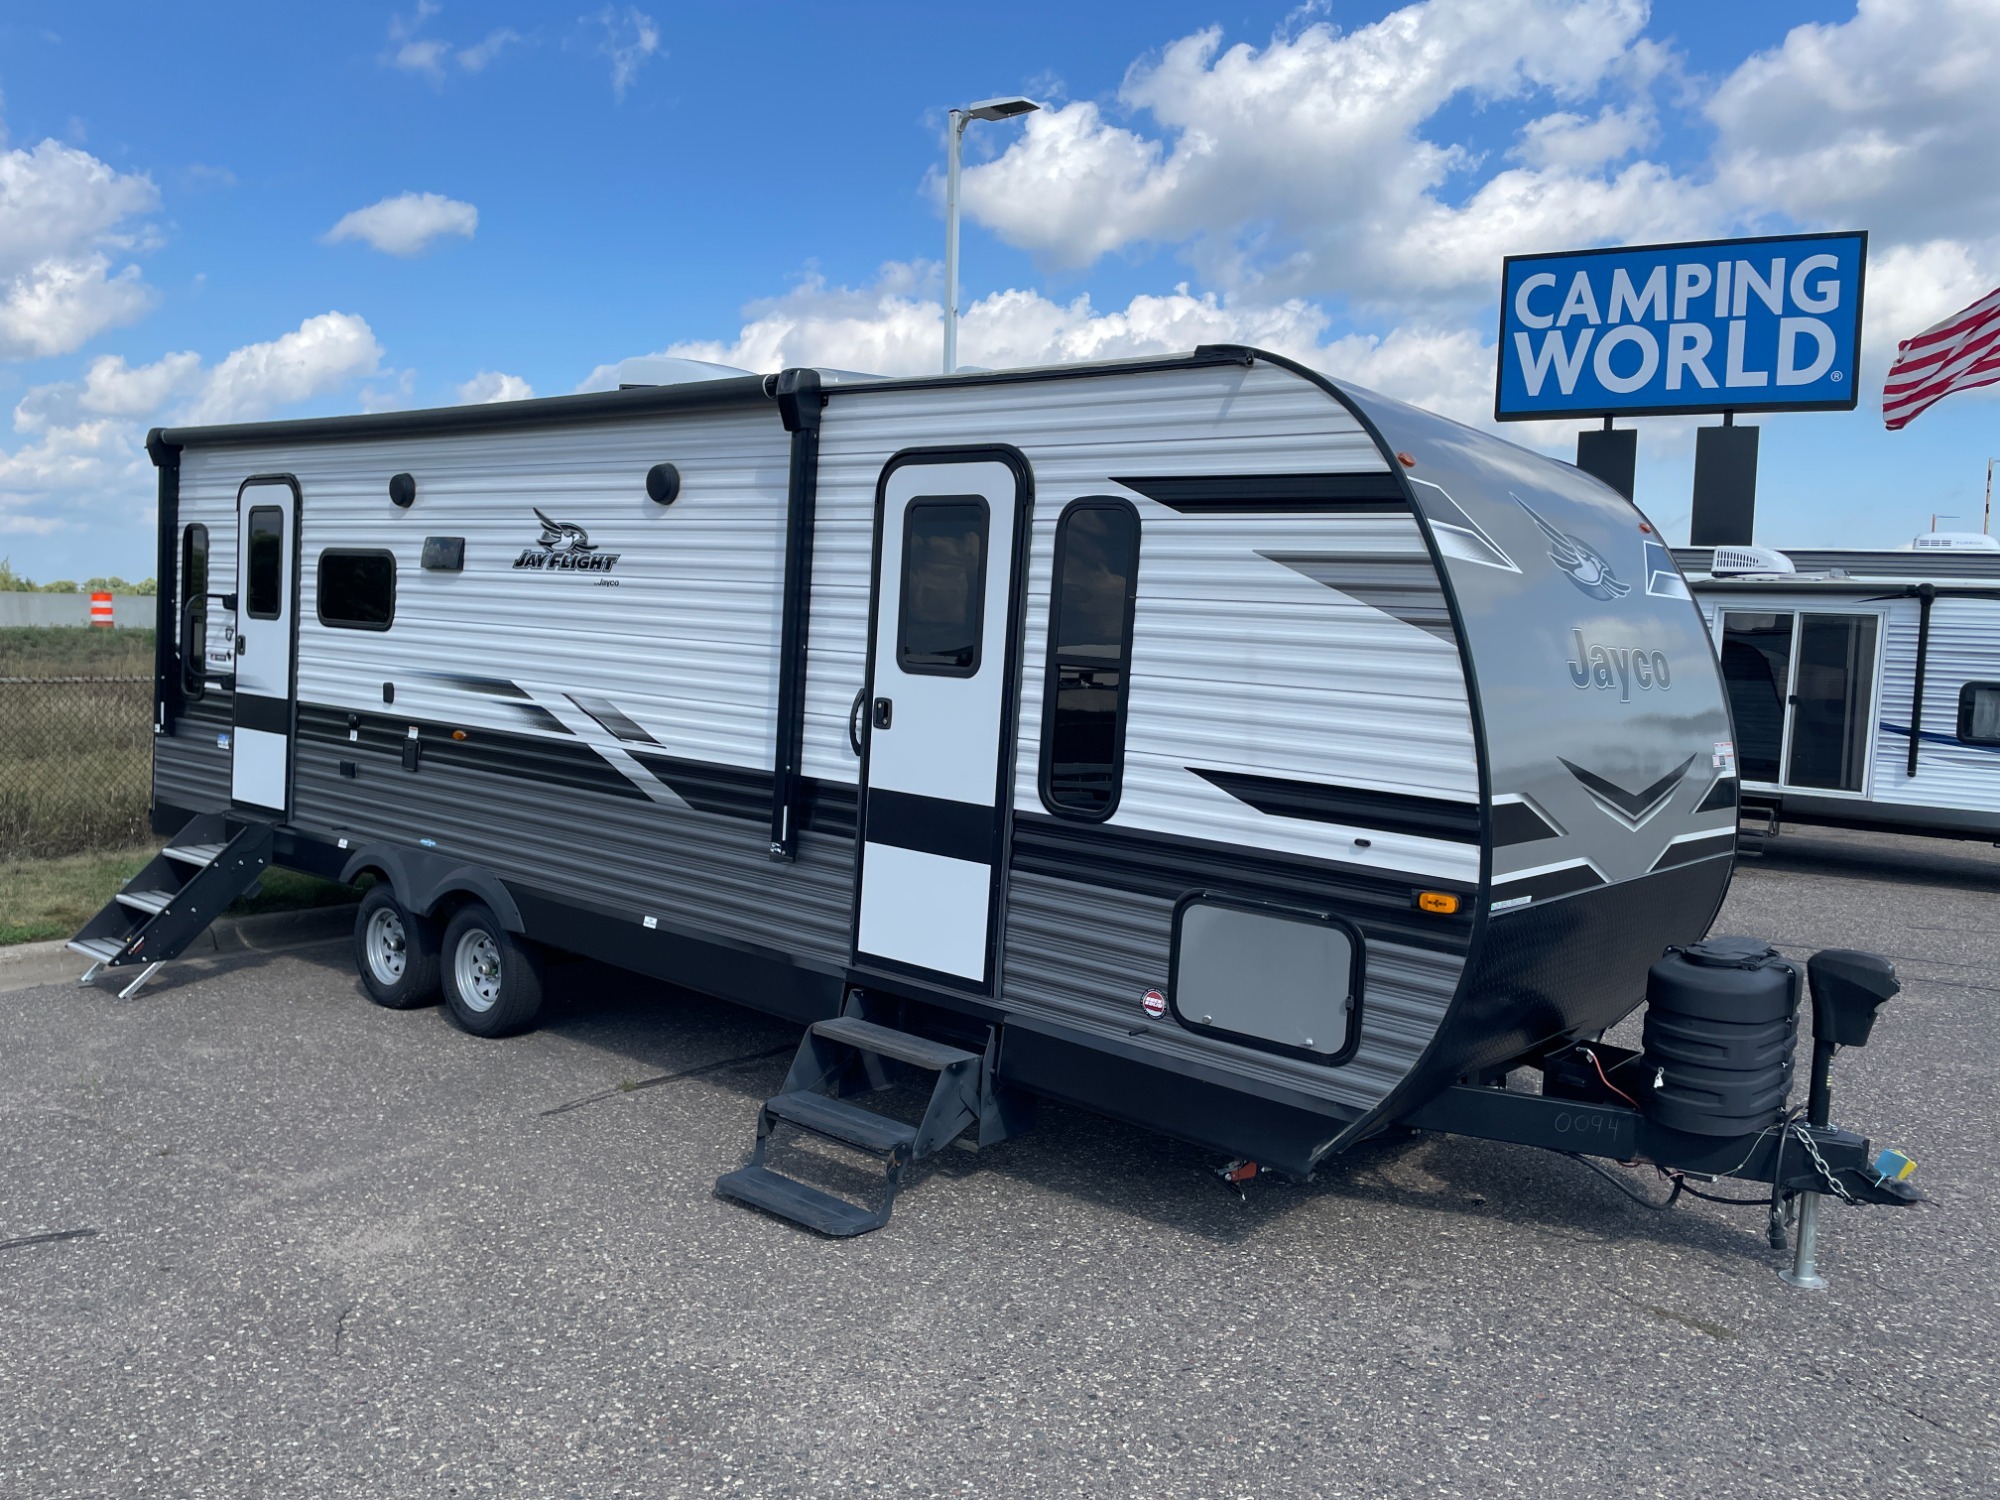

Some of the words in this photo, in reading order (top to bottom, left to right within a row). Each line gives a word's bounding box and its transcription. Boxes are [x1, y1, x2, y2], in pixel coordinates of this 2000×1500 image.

[1515, 254, 1841, 329] CAMPING
[1513, 316, 1837, 397] WORLD
[512, 549, 549, 570] JAY
[547, 551, 621, 572] FLIGHT
[597, 578, 620, 587] Jayco
[1566, 627, 1672, 703] Jayco
[1554, 1112, 1620, 1142] 0094
